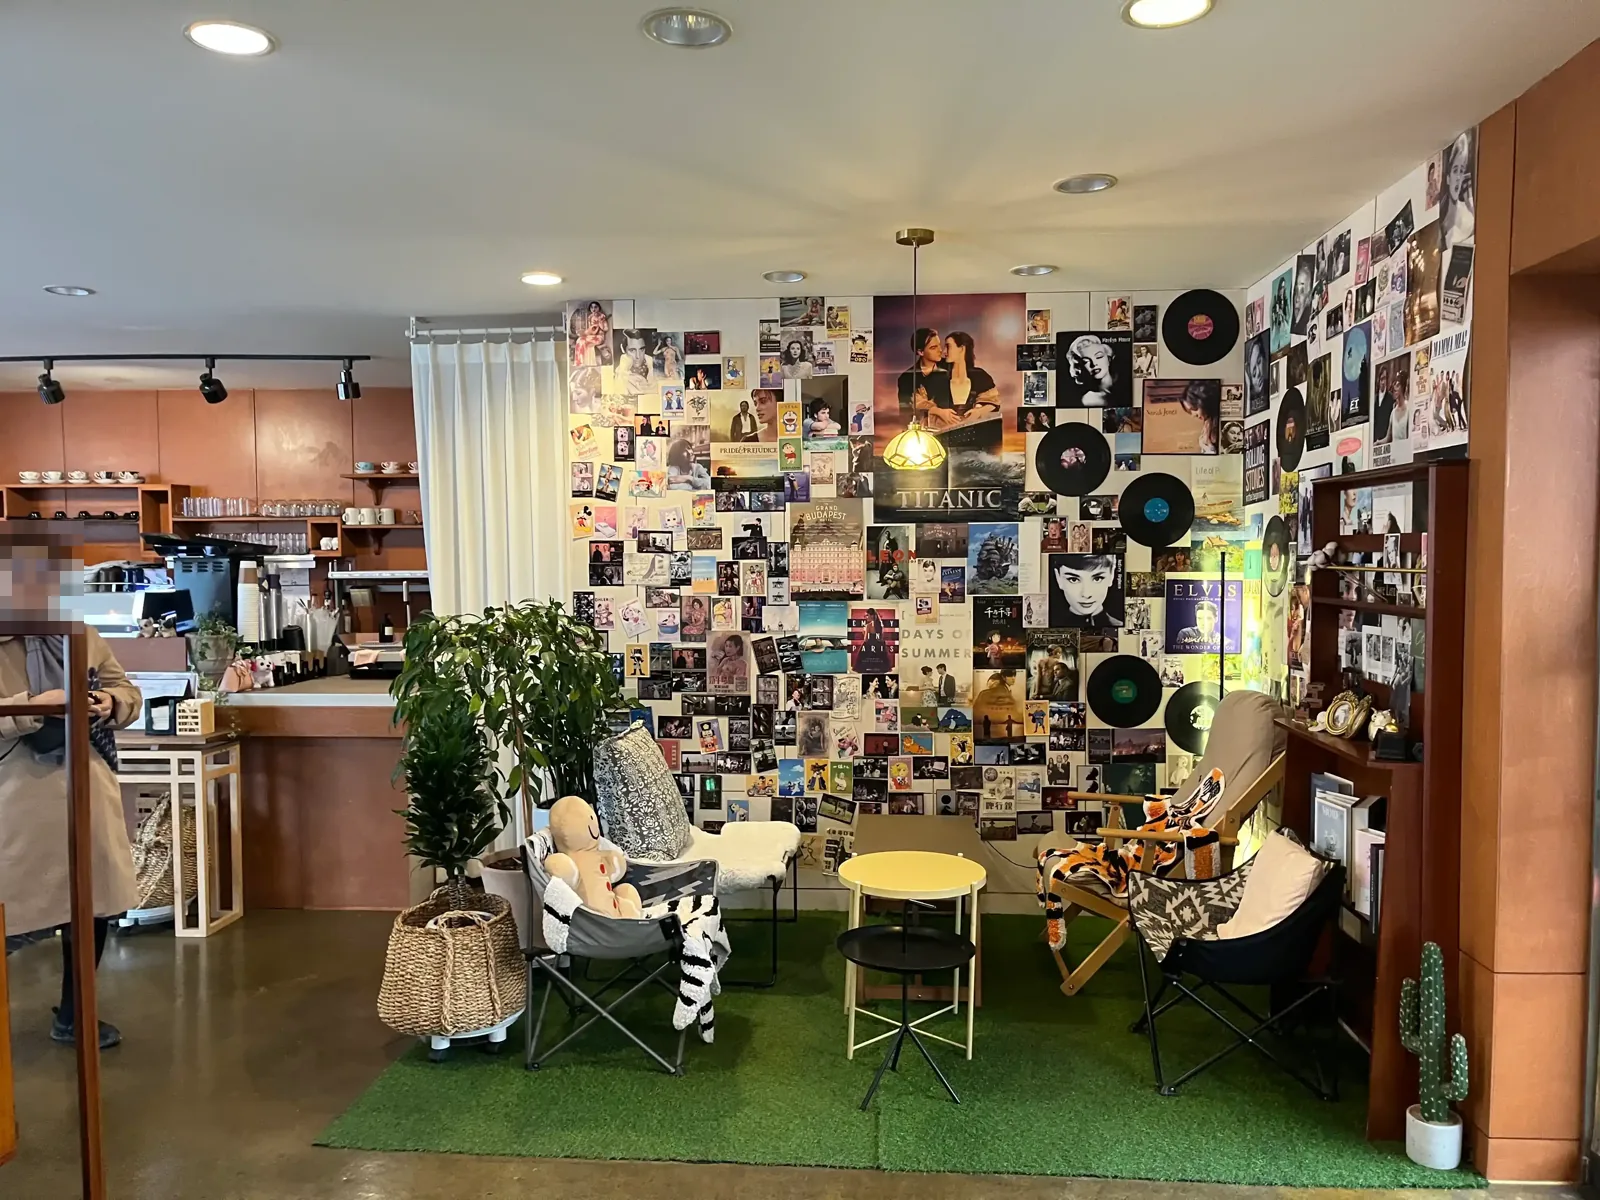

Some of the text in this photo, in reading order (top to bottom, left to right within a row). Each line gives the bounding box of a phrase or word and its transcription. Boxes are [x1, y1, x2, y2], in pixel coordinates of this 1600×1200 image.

[1163, 407, 1178, 417] Jones
[719, 447, 739, 455] PRIDE
[742, 446, 778, 455] PREJUDICE
[1195, 467, 1207, 475] Life
[1245, 466, 1265, 492] STONES
[896, 490, 1002, 509] TITANIC
[805, 510, 847, 521] BUDAPEST
[866, 549, 917, 561] LEON
[1174, 584, 1237, 597] ELVIS
[867, 632, 880, 640] IN
[901, 629, 945, 639] DAYS
[852, 645, 894, 653] PARIS
[901, 648, 972, 658] SUMMER
